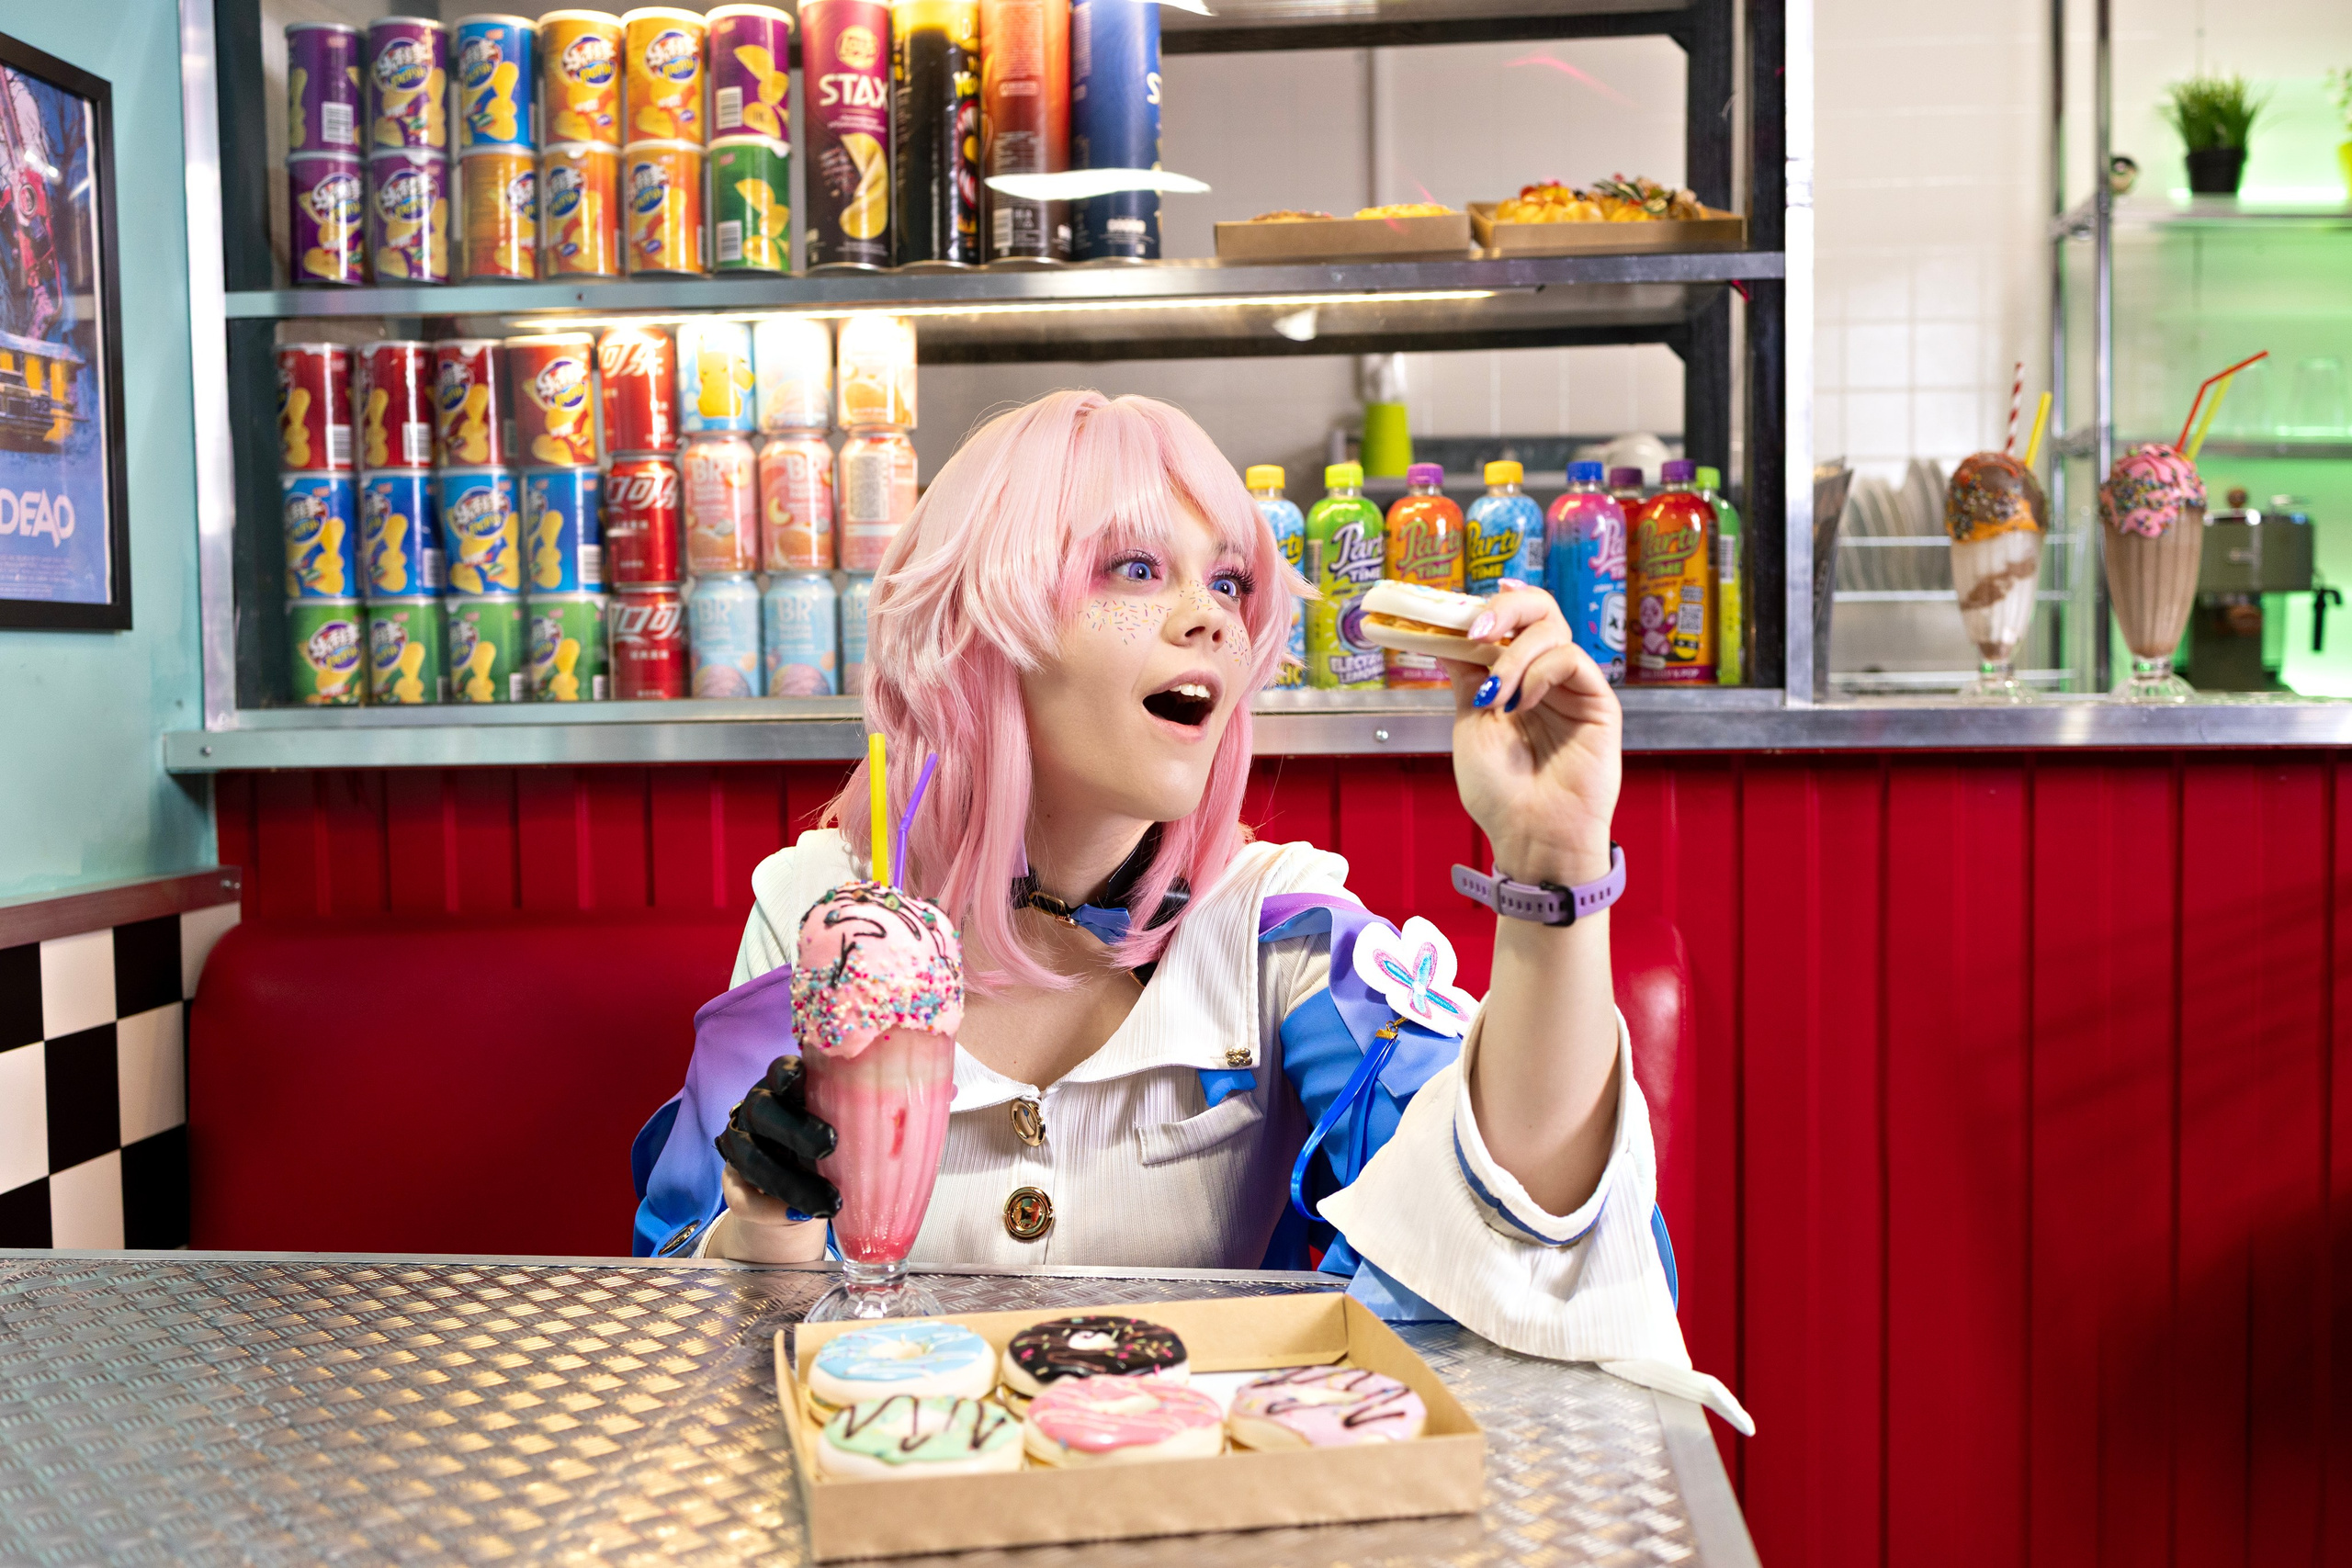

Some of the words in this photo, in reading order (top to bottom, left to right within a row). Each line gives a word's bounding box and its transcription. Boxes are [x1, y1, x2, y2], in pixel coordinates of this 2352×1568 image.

[819, 73, 888, 110] STAX
[0, 488, 75, 548] DEAD
[1637, 518, 1702, 567] Party
[1329, 521, 1385, 573] Part
[1396, 520, 1462, 573] Party
[1465, 520, 1524, 571] Party
[698, 598, 731, 622] BR
[777, 597, 812, 622] BR
